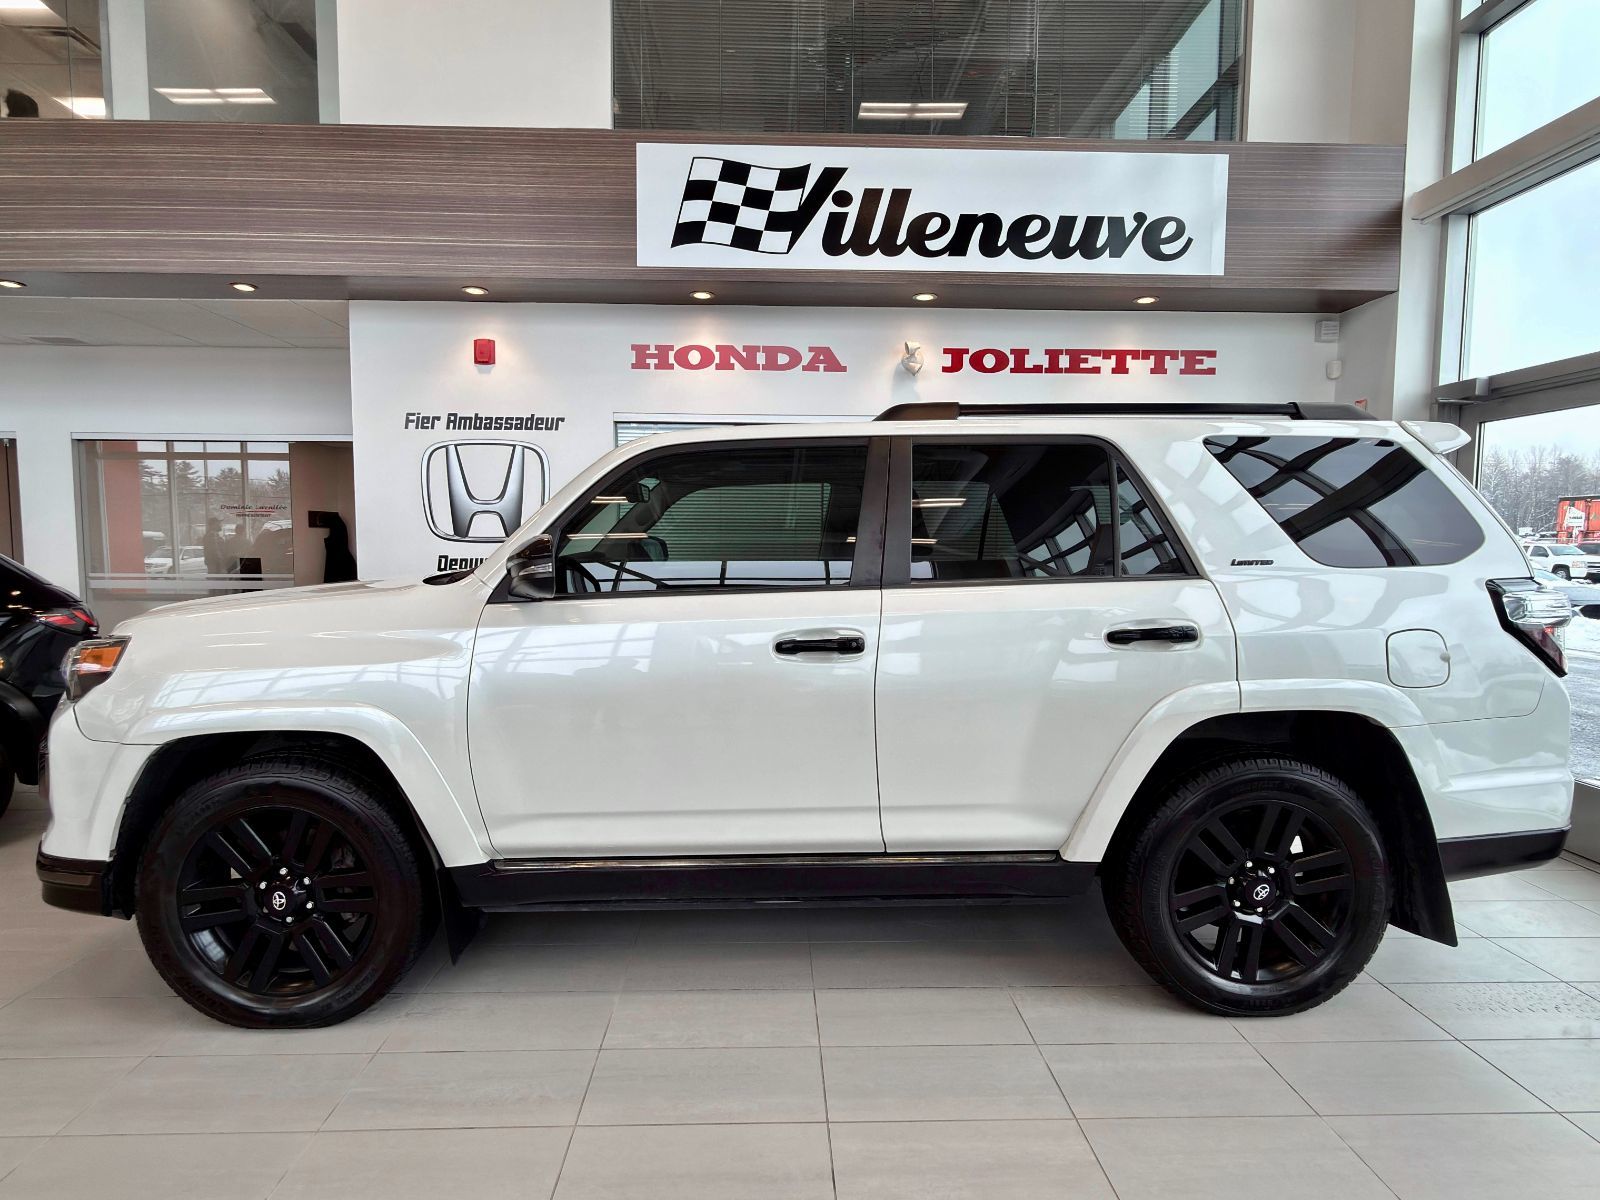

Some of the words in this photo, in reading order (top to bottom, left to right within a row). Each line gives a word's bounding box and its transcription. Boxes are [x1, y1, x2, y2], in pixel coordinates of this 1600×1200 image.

[786, 166, 1193, 262] Villeneuve
[631, 344, 847, 372] HONDA
[941, 348, 1217, 375] JOLIETTE
[404, 412, 441, 430] Fier
[446, 412, 566, 431] Ambassadeur
